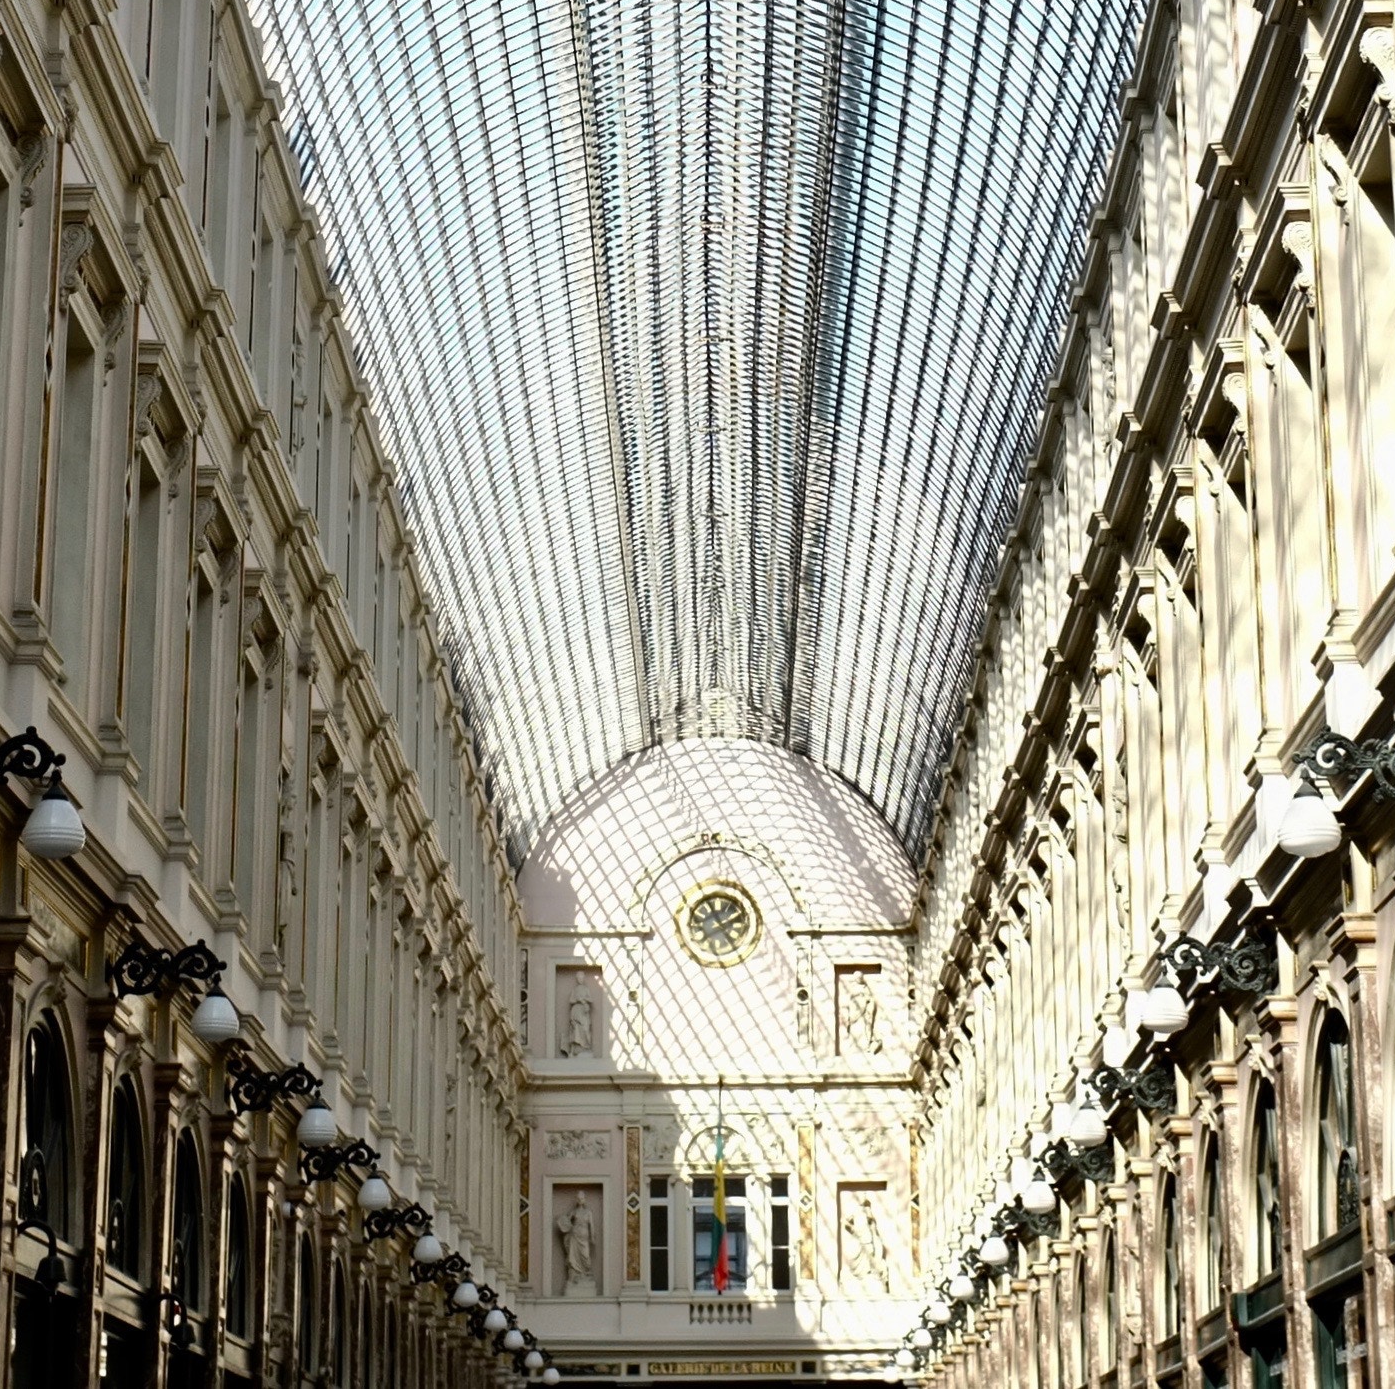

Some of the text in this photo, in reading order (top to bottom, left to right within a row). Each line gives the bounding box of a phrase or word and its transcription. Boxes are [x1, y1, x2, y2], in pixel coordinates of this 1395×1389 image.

[649, 1361, 794, 1375] GALERIE DE LA REINE
